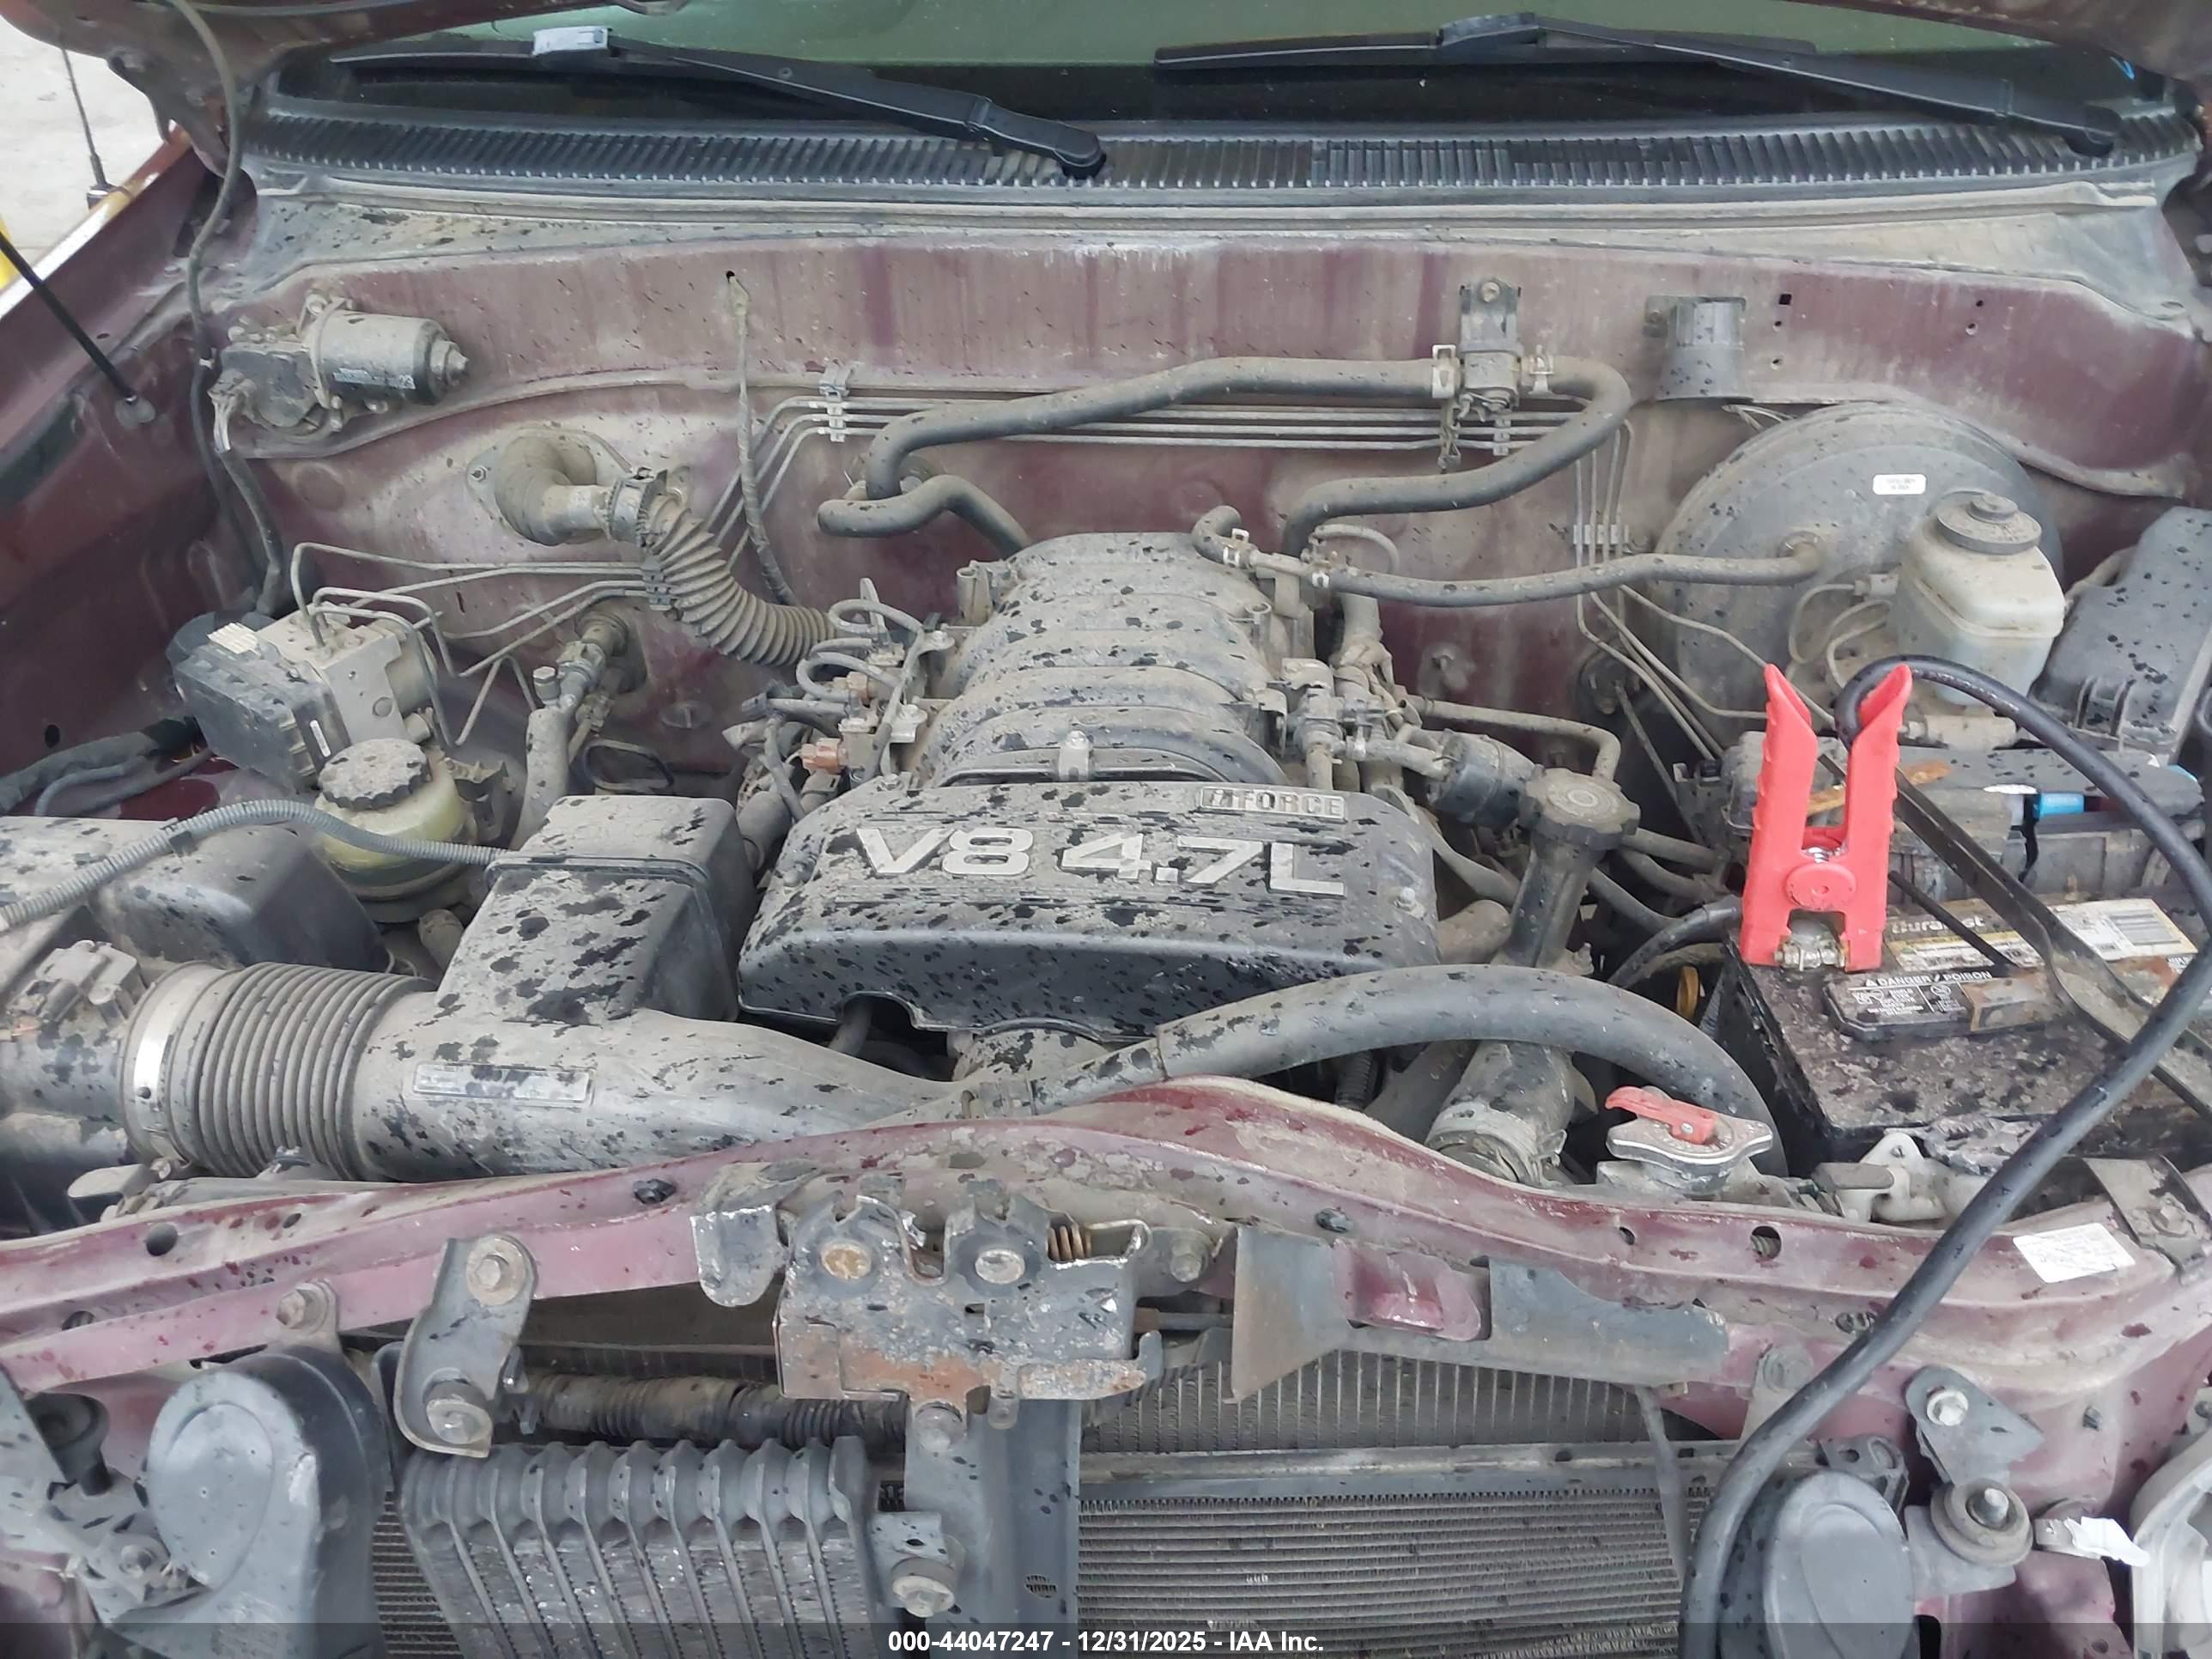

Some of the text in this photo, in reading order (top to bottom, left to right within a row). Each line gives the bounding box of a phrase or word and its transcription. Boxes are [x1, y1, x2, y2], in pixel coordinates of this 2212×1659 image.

[857, 827, 1344, 896] V8 4.7L
[1877, 975, 1931, 986] DANGER
[1942, 971, 1992, 981] POISON
